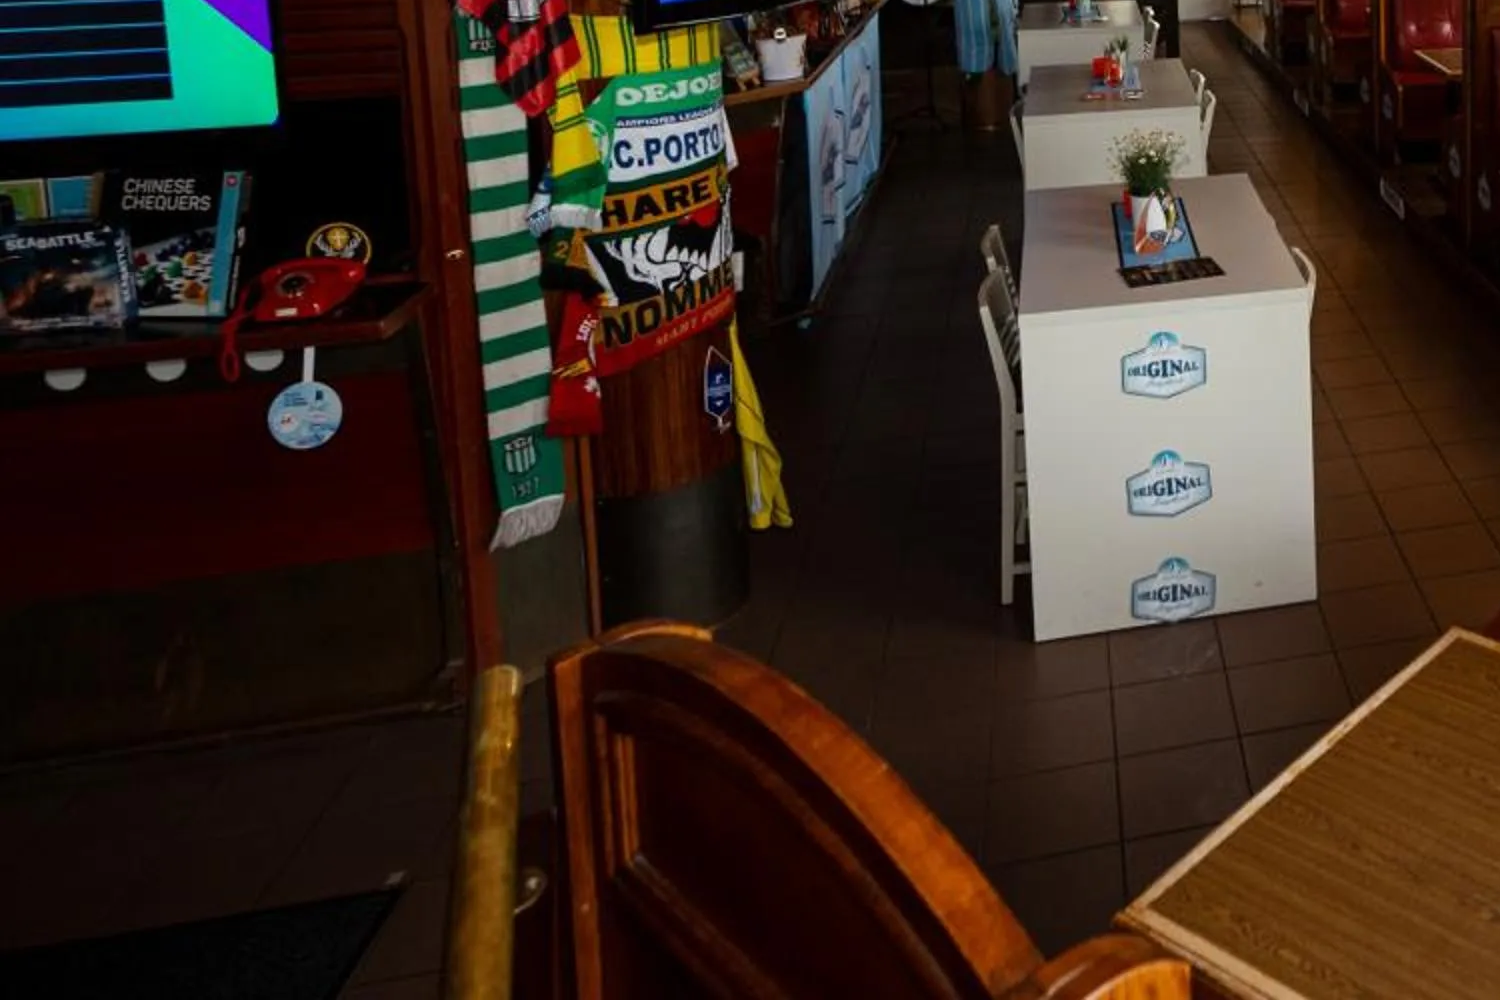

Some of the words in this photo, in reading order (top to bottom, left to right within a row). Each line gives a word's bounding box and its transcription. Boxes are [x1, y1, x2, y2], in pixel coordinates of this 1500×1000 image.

[124, 178, 196, 195] CHINESE
[122, 195, 212, 211] CHEQUERS
[1127, 359, 1199, 378] ORIGINAL
